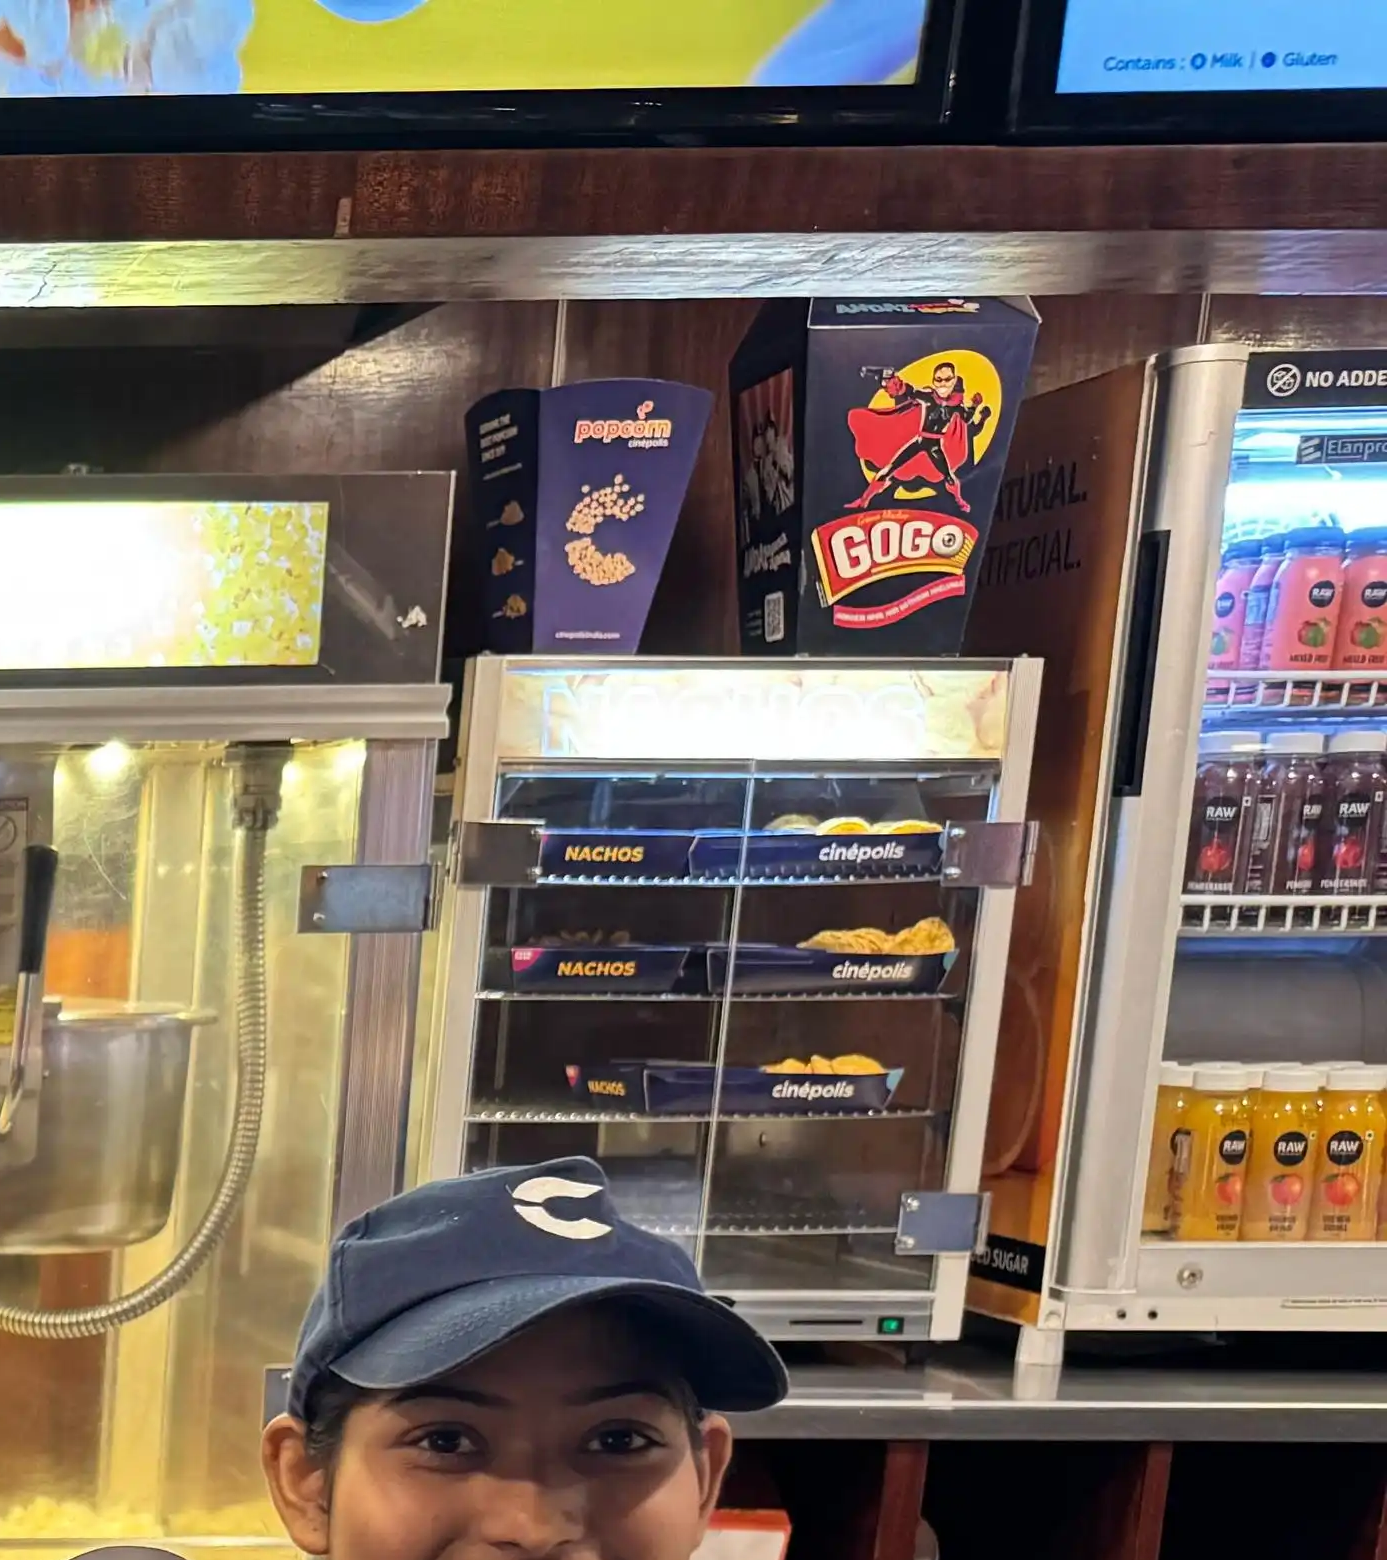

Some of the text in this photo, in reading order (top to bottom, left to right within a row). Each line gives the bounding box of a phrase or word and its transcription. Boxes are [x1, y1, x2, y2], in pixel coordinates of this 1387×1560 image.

[1305, 370, 1335, 388] NO
[574, 418, 672, 444] popcorn
[831, 519, 965, 579] GOGO
[1206, 806, 1238, 818] RAW
[1339, 802, 1371, 815] RAW
[565, 846, 645, 863] NACHOS
[819, 841, 904, 864] cinépolis
[557, 960, 637, 977] NACHOS
[831, 960, 913, 981] cinépolis
[771, 1080, 855, 1101] cinépolis
[1223, 1139, 1246, 1154] RAW
[1277, 1141, 1306, 1154] RAW
[1329, 1139, 1359, 1154] RAW
[991, 1248, 1029, 1275] SUGAR
